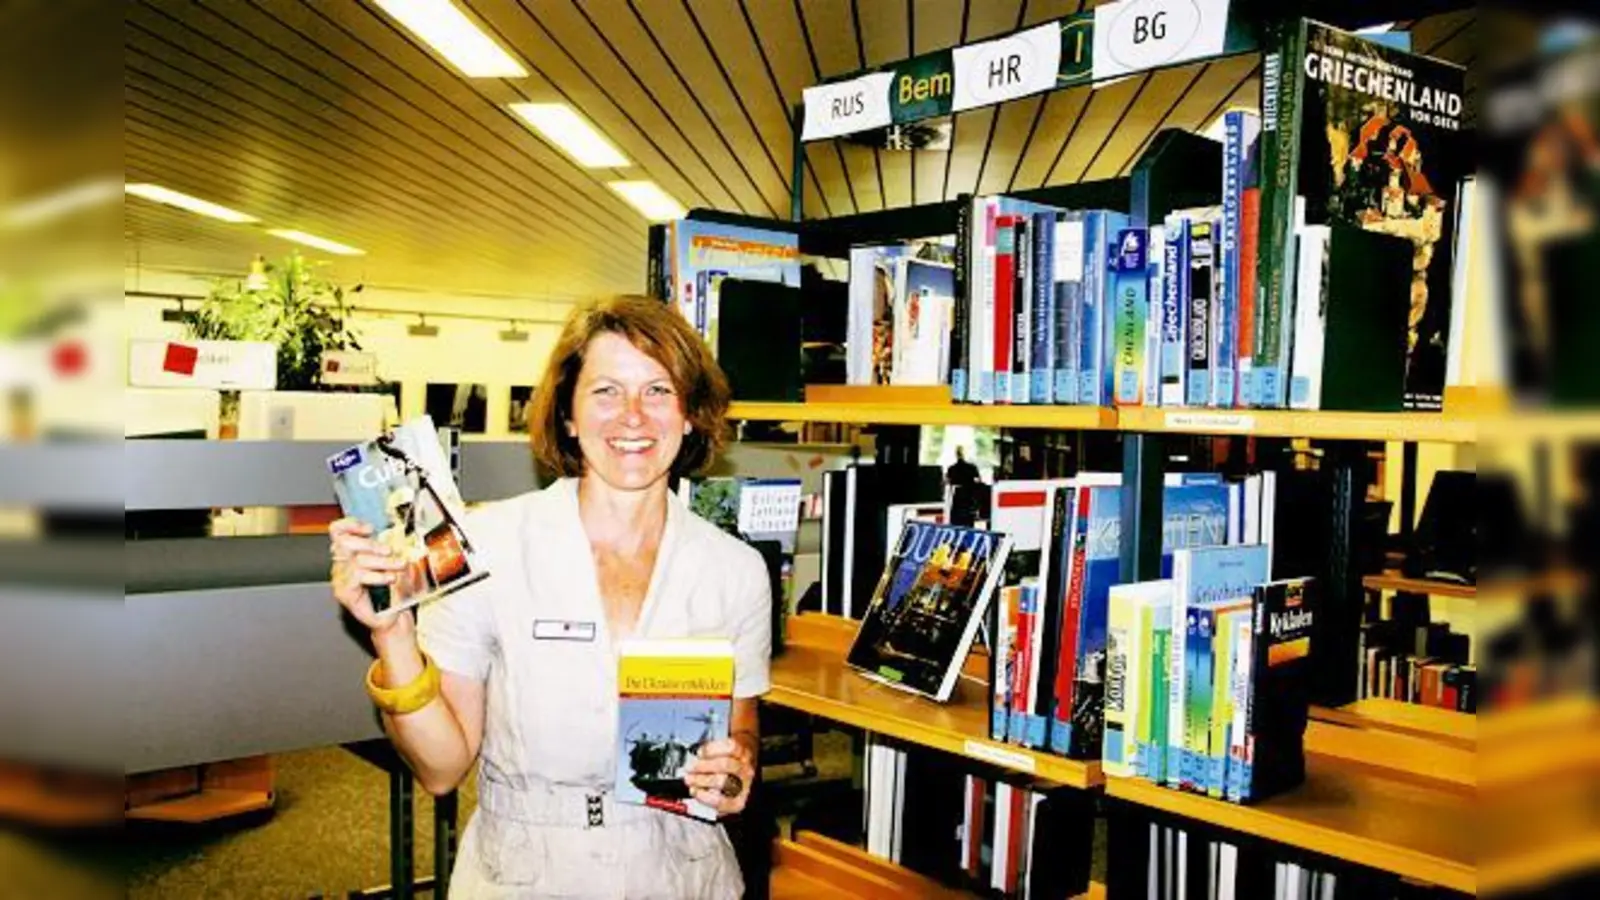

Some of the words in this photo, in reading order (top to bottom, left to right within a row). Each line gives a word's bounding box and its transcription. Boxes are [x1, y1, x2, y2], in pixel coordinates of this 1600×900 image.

[1133, 11, 1167, 45] BG
[899, 71, 951, 104] Bem
[987, 54, 1022, 89] HR
[1303, 52, 1462, 117] GRIECHENLAND
[830, 91, 865, 119] RUS
[898, 522, 993, 579] DUBLIN
[1270, 608, 1313, 639] Kykladen
